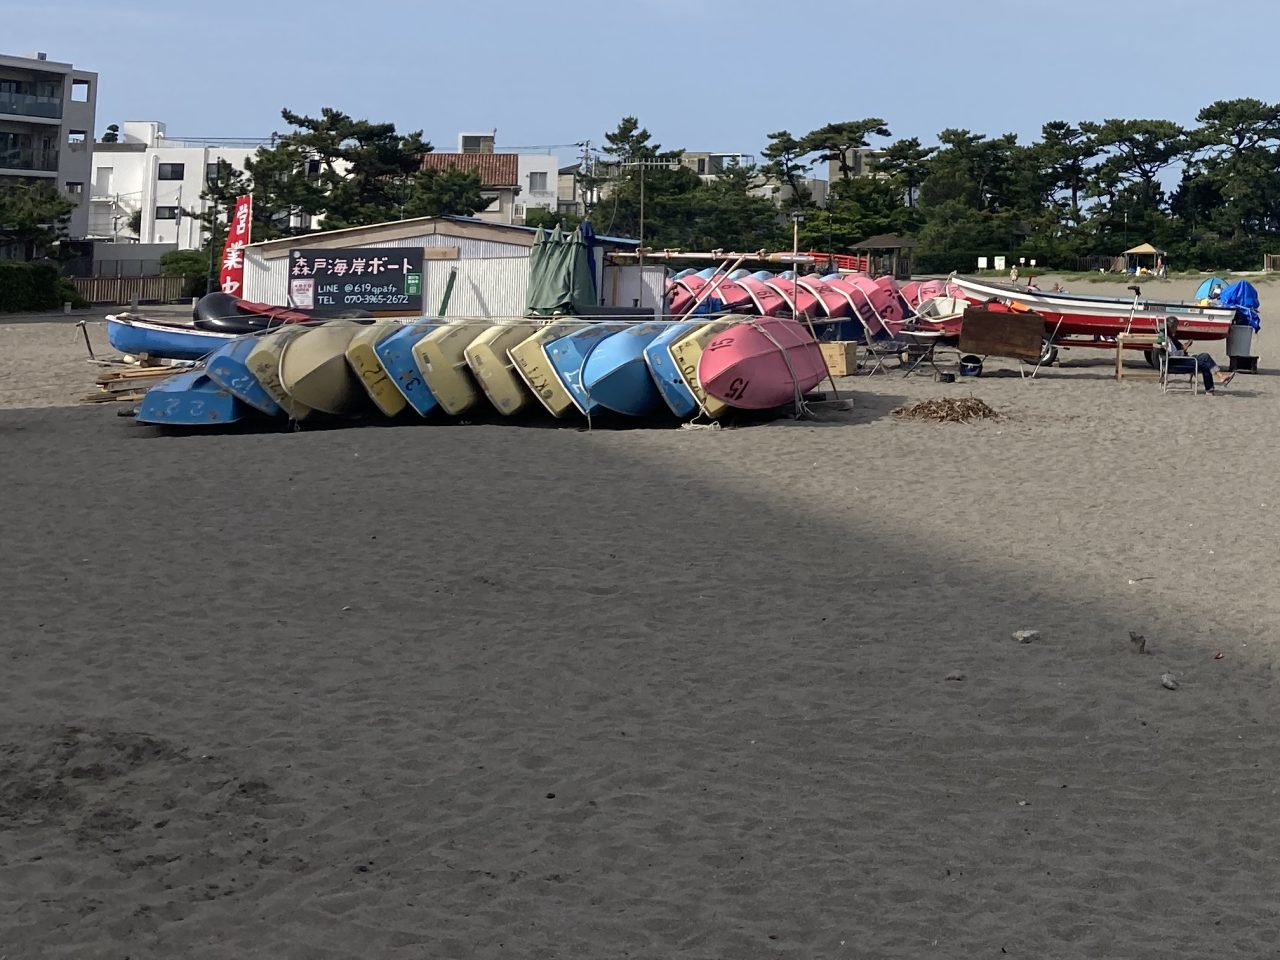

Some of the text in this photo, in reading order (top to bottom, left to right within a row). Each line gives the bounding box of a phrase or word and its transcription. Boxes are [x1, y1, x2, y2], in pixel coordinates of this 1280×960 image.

[291, 256, 413, 277] 森戸海岸ボート
[318, 283, 339, 293] LINE
[318, 295, 336, 305] TEL
[344, 294, 409, 304] 070-3965-2672
[708, 338, 735, 352] 15
[724, 377, 750, 401] 15
